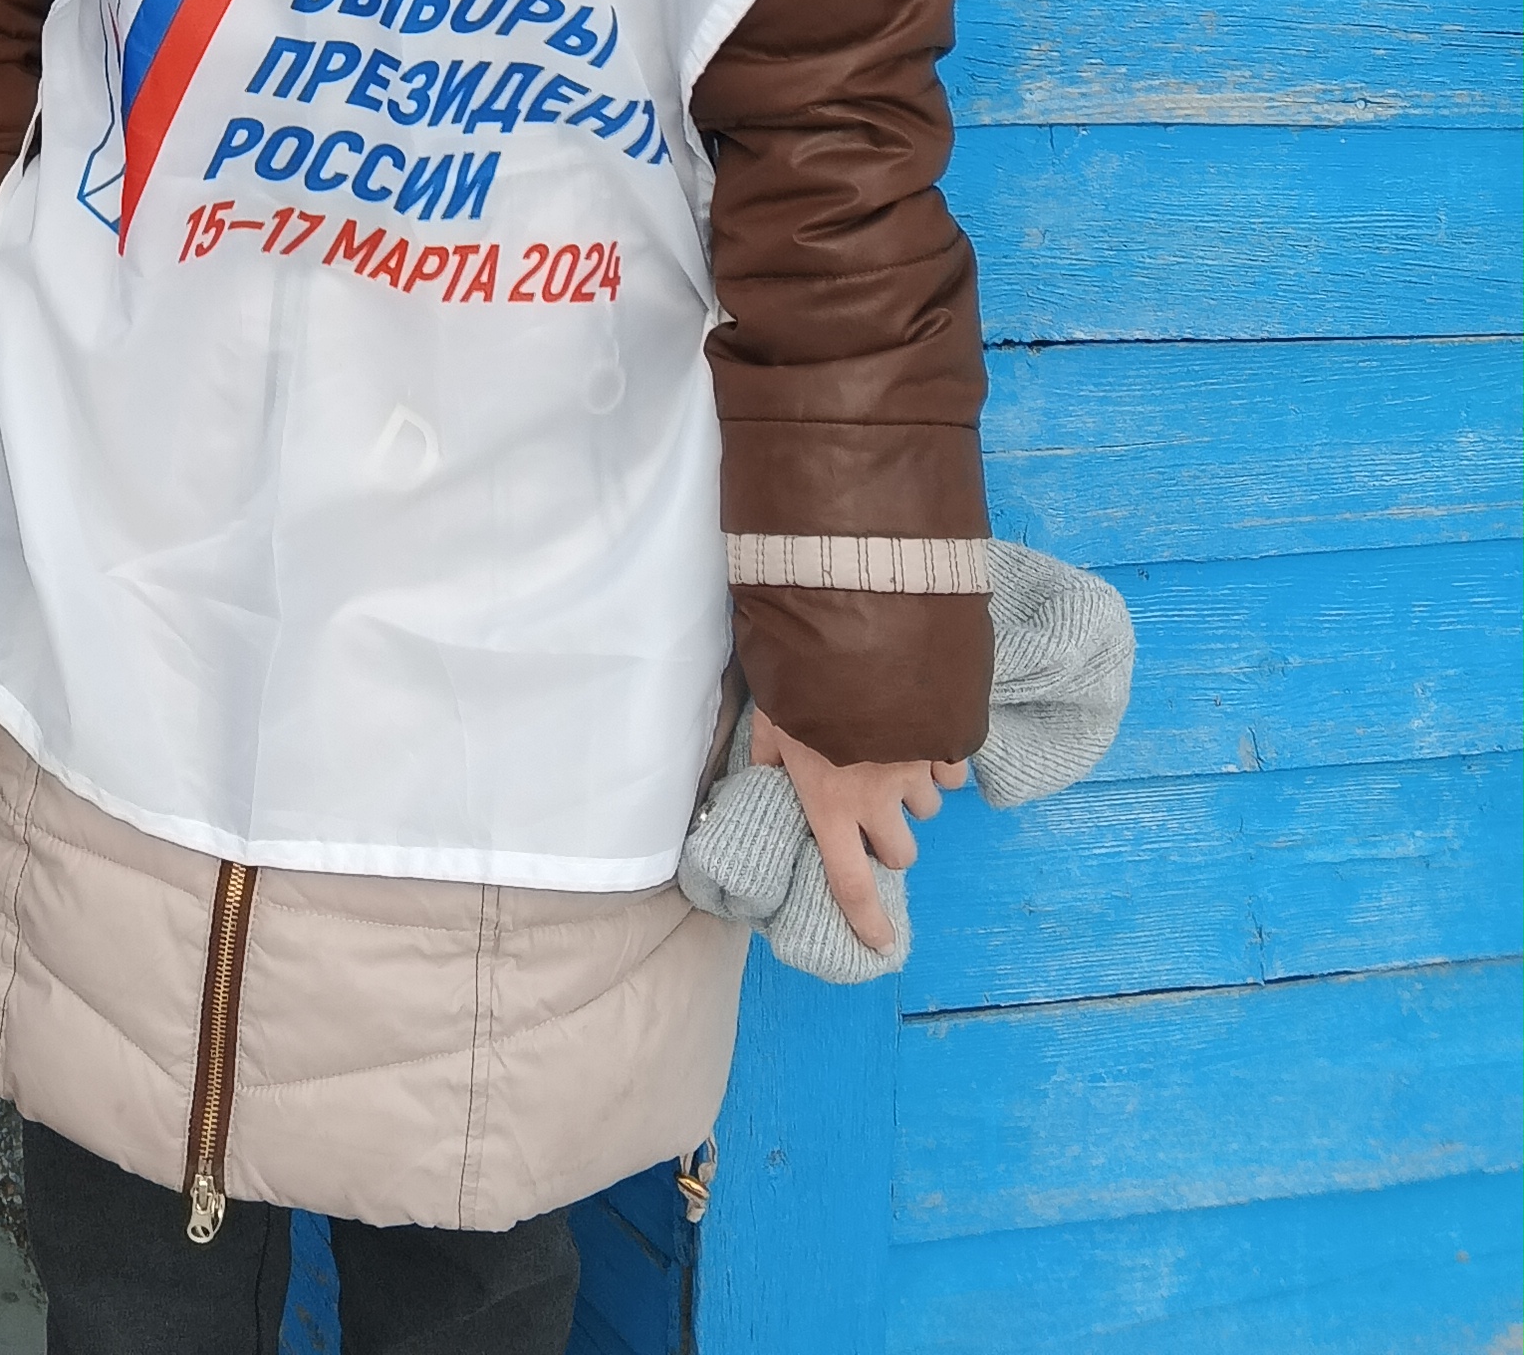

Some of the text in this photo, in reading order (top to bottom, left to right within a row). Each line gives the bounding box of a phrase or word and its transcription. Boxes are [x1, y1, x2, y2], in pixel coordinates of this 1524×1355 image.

[203, 118, 501, 221] РОССИИ
[322, 219, 500, 303] МАРТА
[508, 240, 621, 303] 2024
